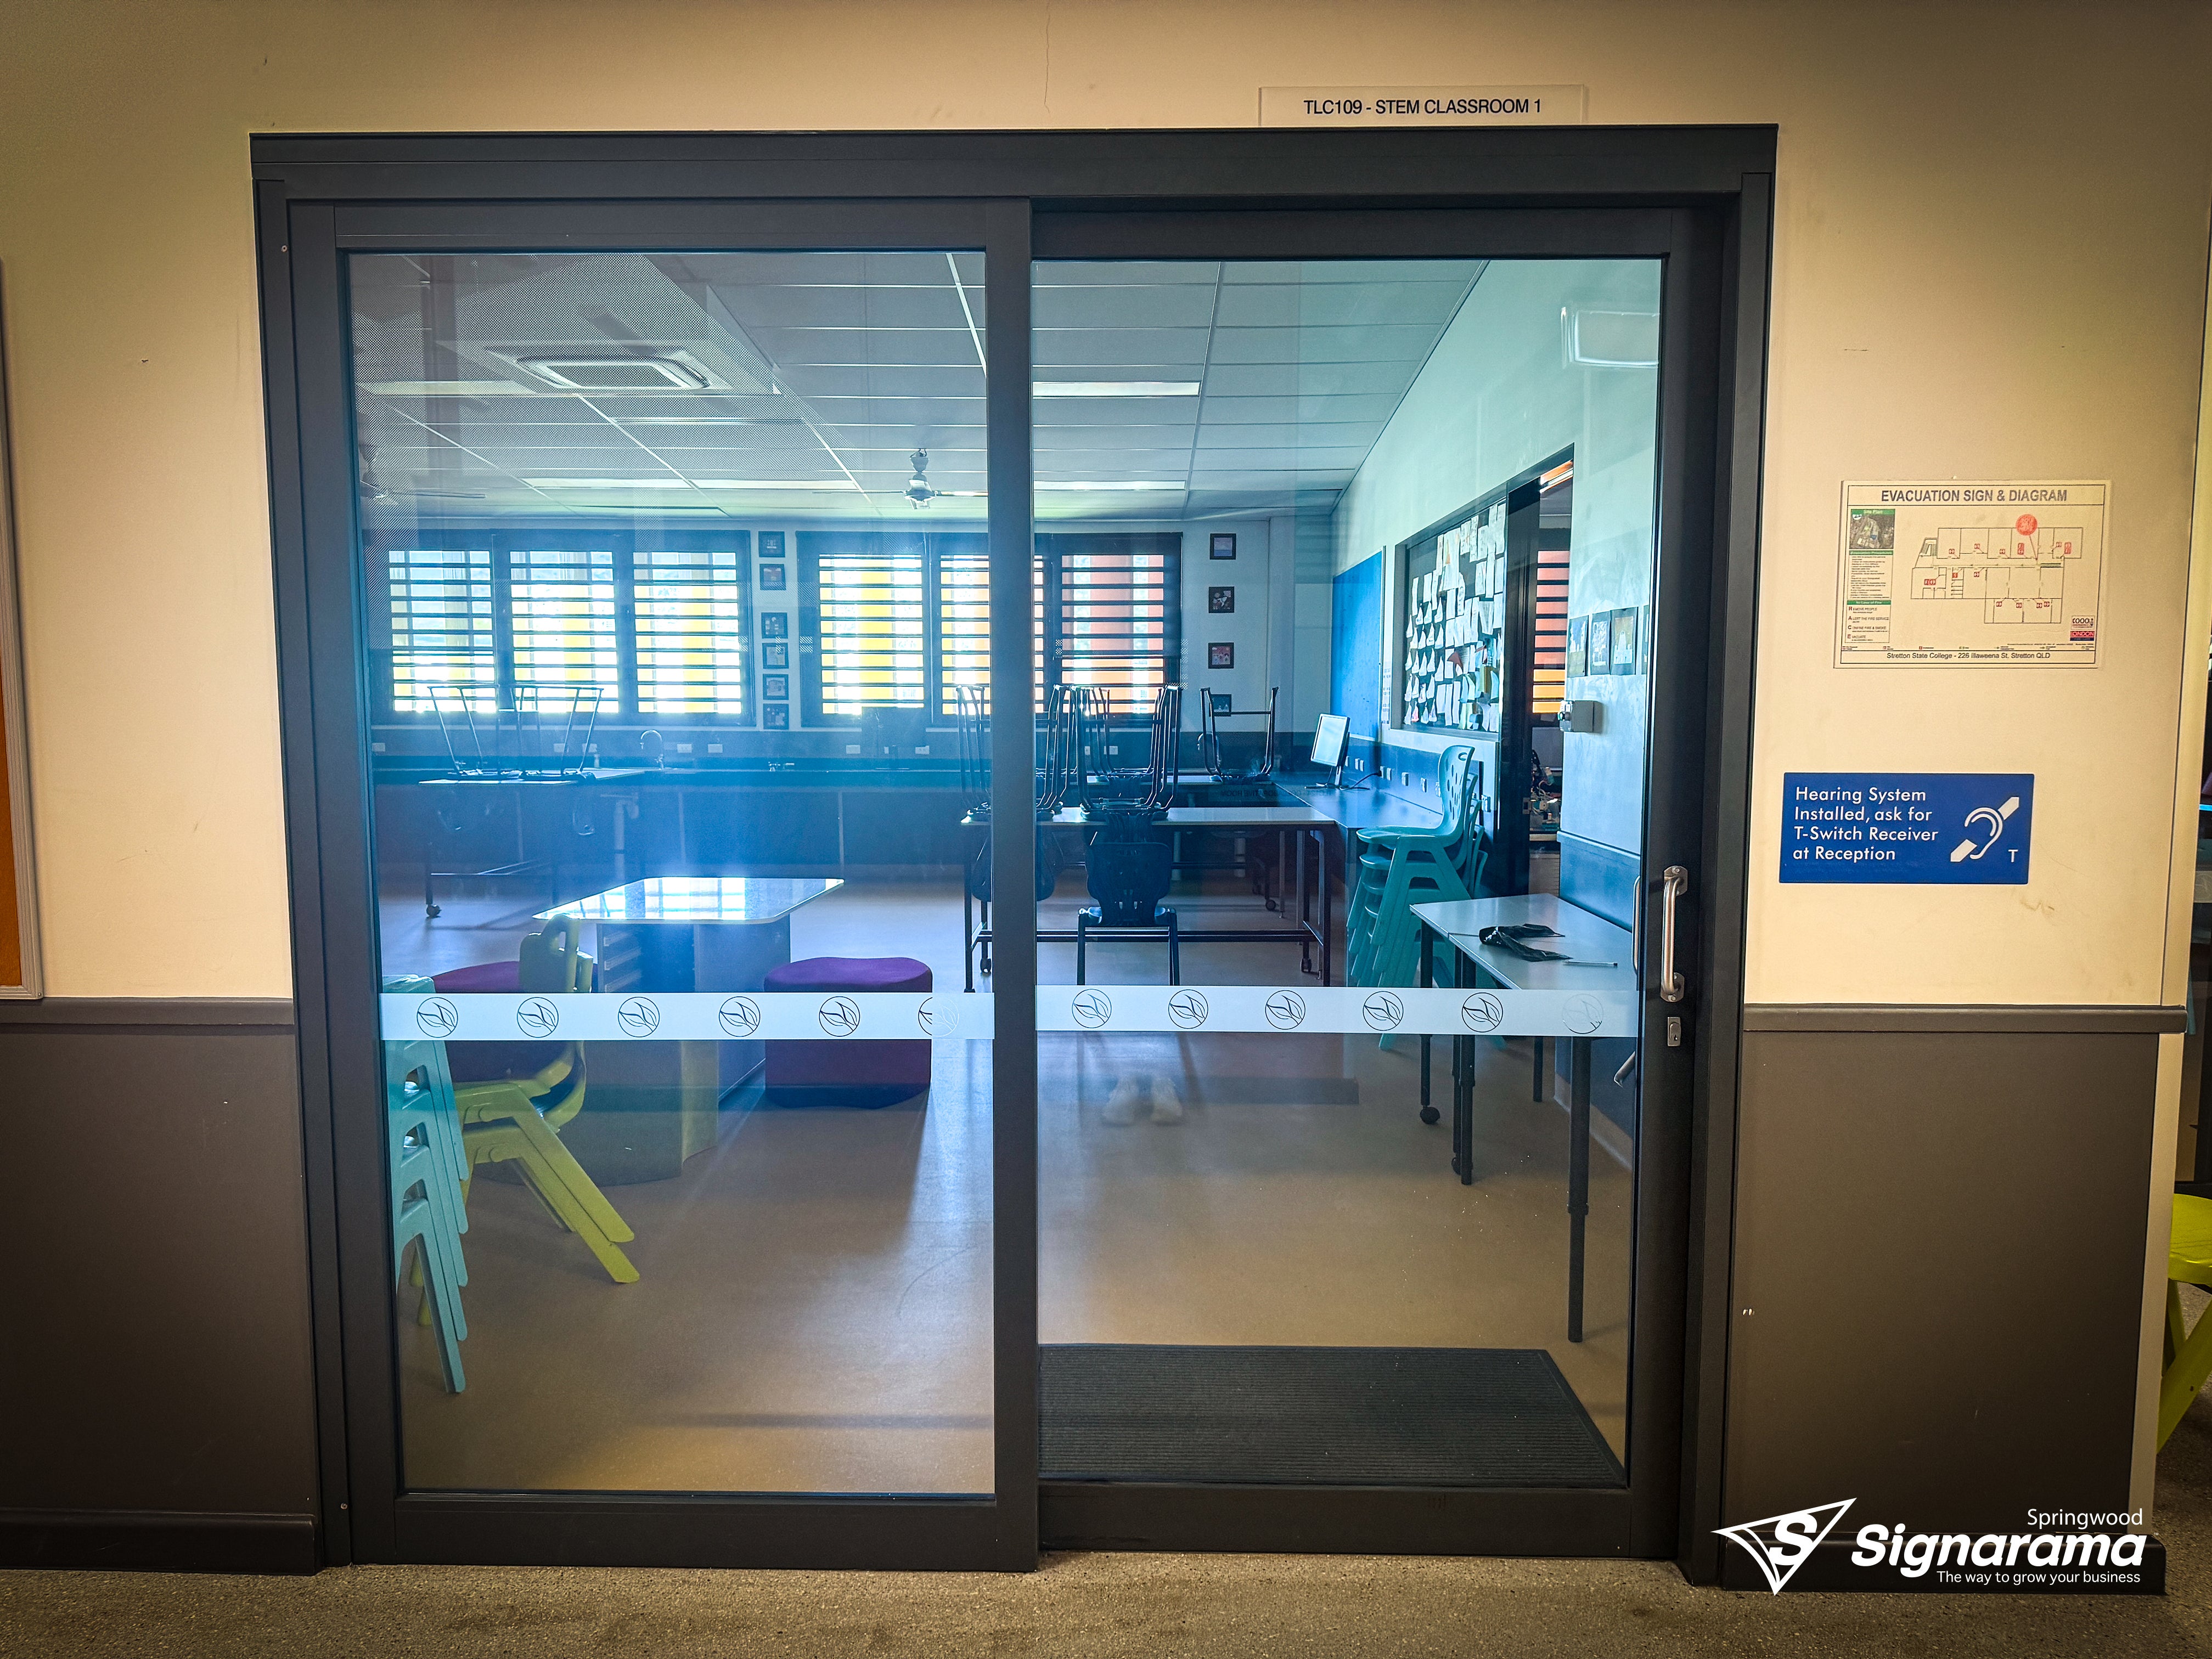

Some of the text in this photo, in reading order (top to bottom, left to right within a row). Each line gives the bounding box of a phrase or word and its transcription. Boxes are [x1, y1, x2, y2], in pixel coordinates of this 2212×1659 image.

[1303, 99, 1362, 114] TLC109
[1375, 99, 1420, 114] STEM
[1424, 99, 1529, 114] CLASSROOM
[1534, 99, 1541, 113] 1
[1881, 489, 2068, 502] EVACUATION SIGN & DIAGRAM
[1796, 787, 1926, 805] Hearing System
[1795, 806, 1933, 824] Installed, ask for
[1794, 826, 1939, 841] T-Switch Receiver
[1793, 846, 1895, 863] at Reception
[2008, 849, 2018, 863] T
